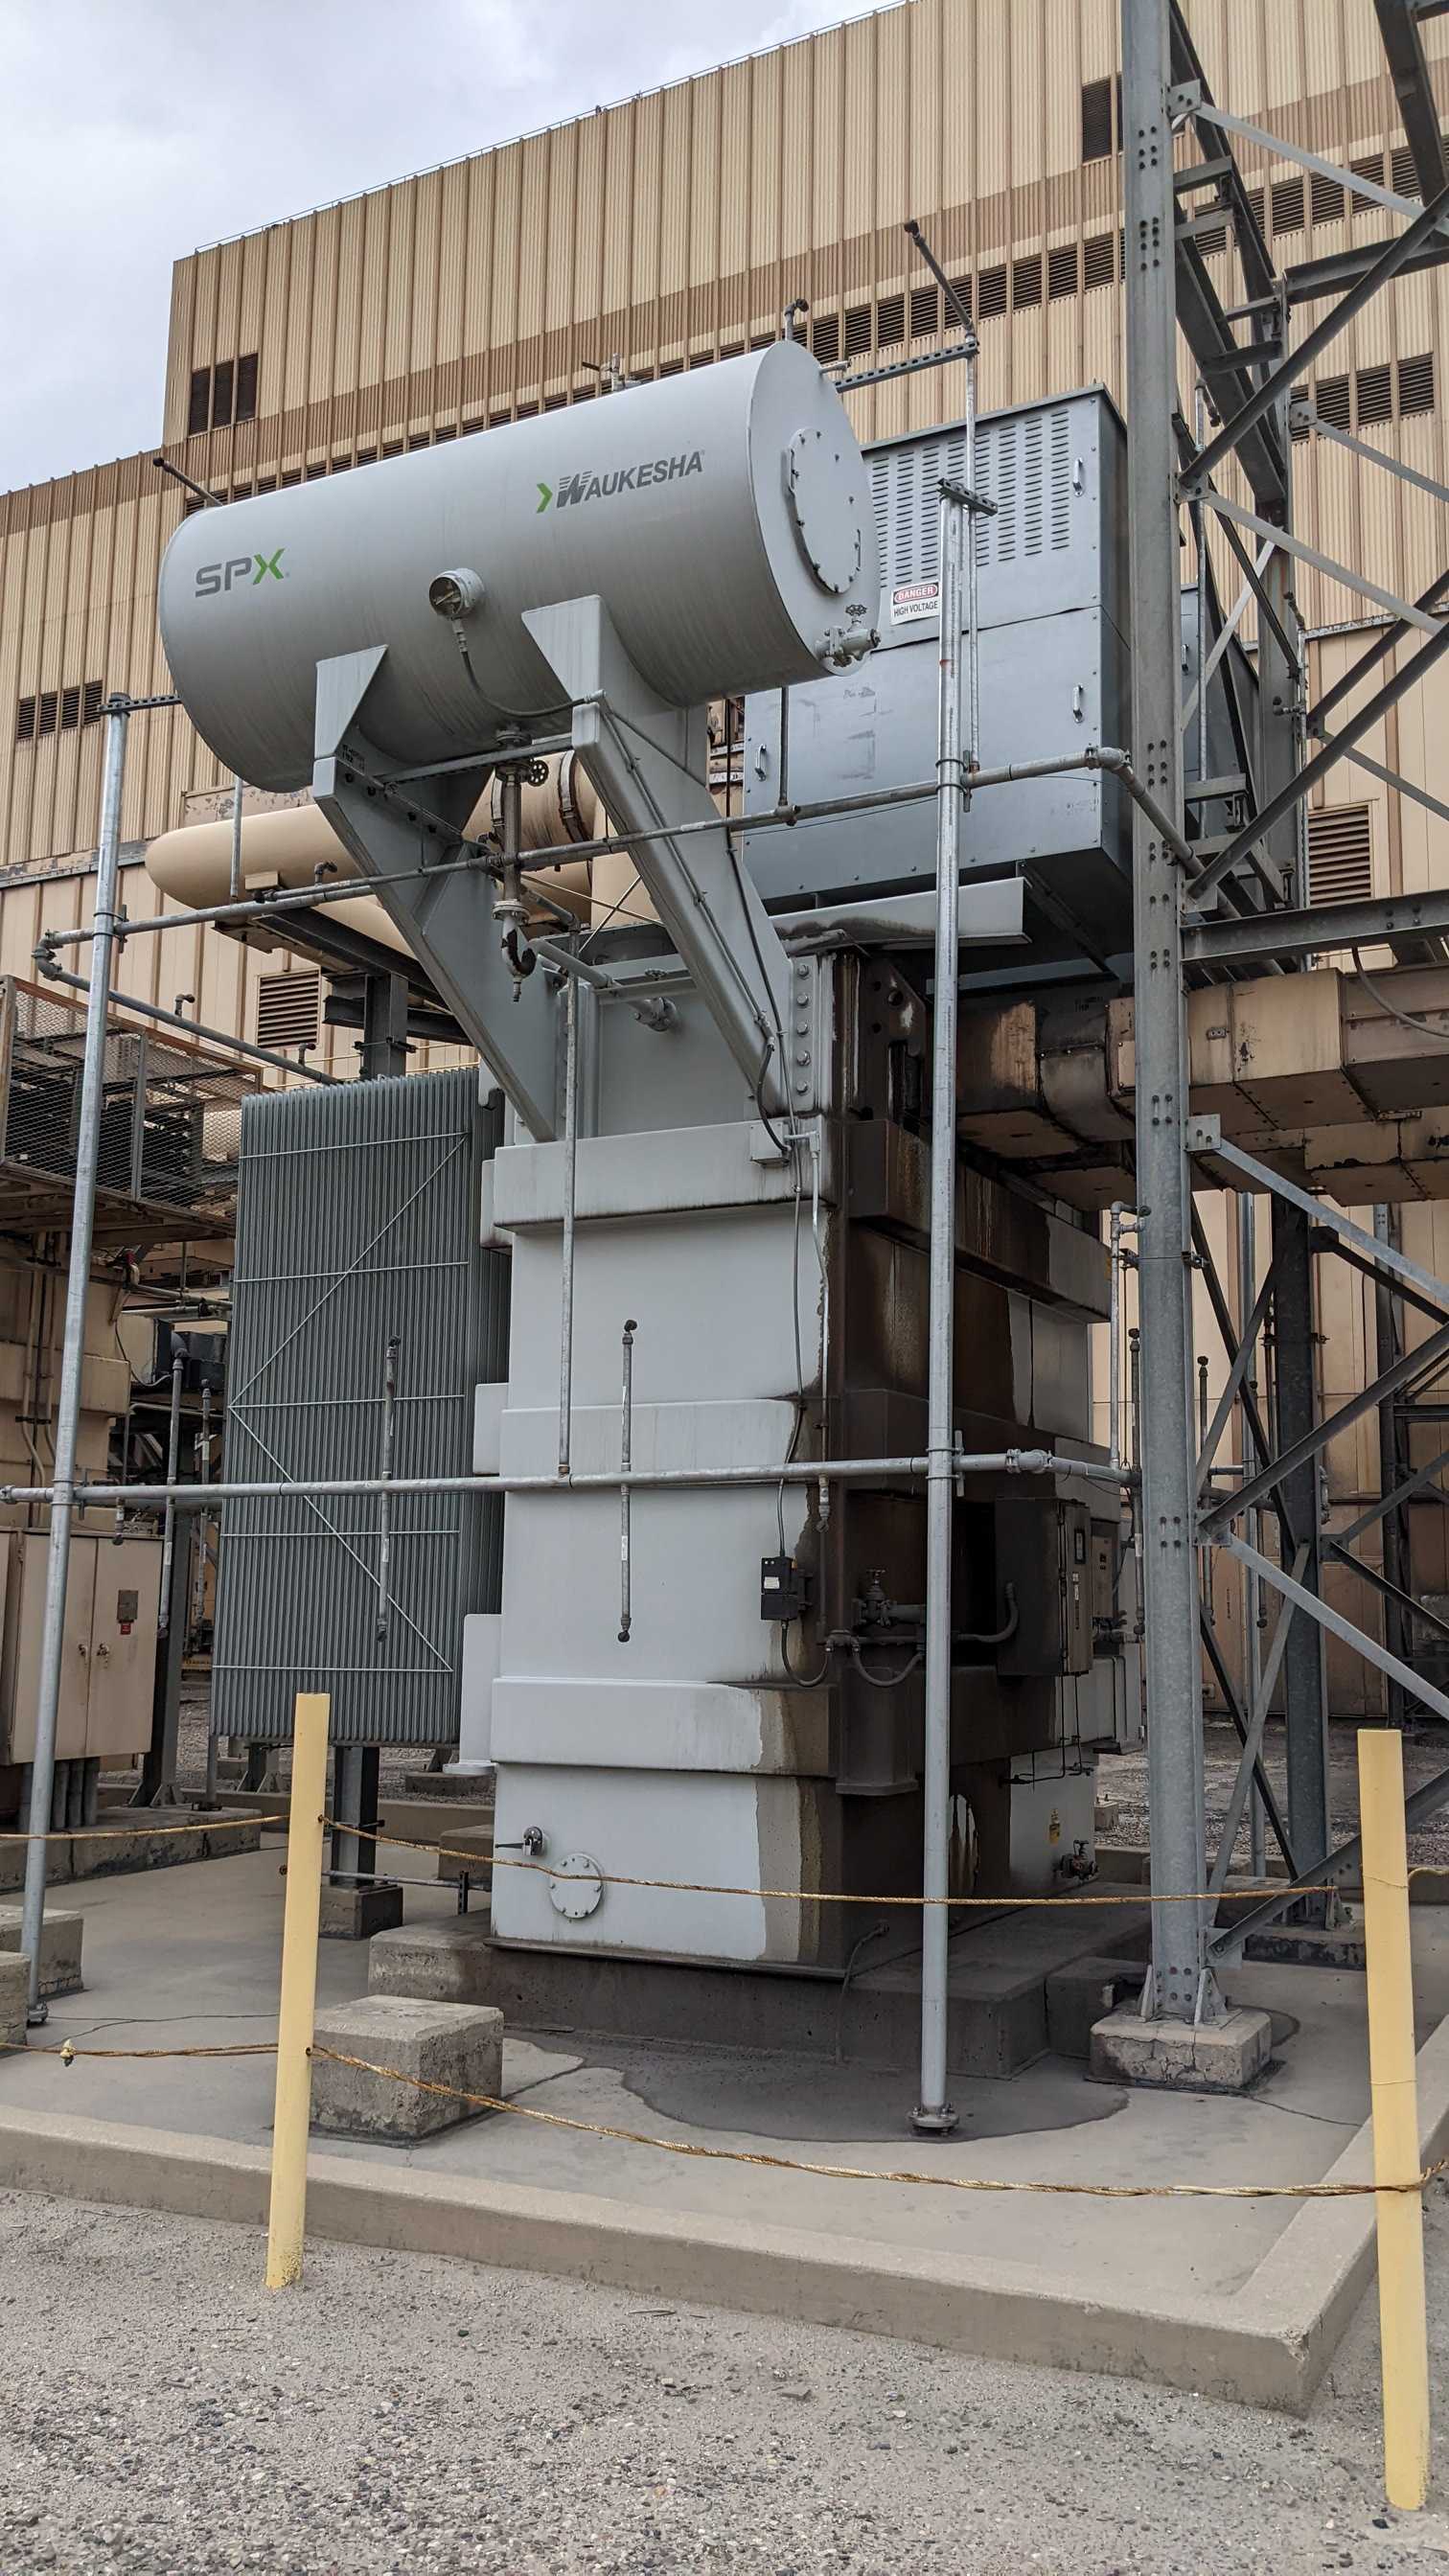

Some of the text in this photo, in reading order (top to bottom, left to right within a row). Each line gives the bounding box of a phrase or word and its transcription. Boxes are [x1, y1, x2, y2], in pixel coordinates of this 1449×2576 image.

[556, 450, 702, 509] WAUKESHA
[195, 548, 285, 598] SPX
[894, 601, 938, 617] HIGH VOLTAGE
[898, 586, 933, 601] DANGER
